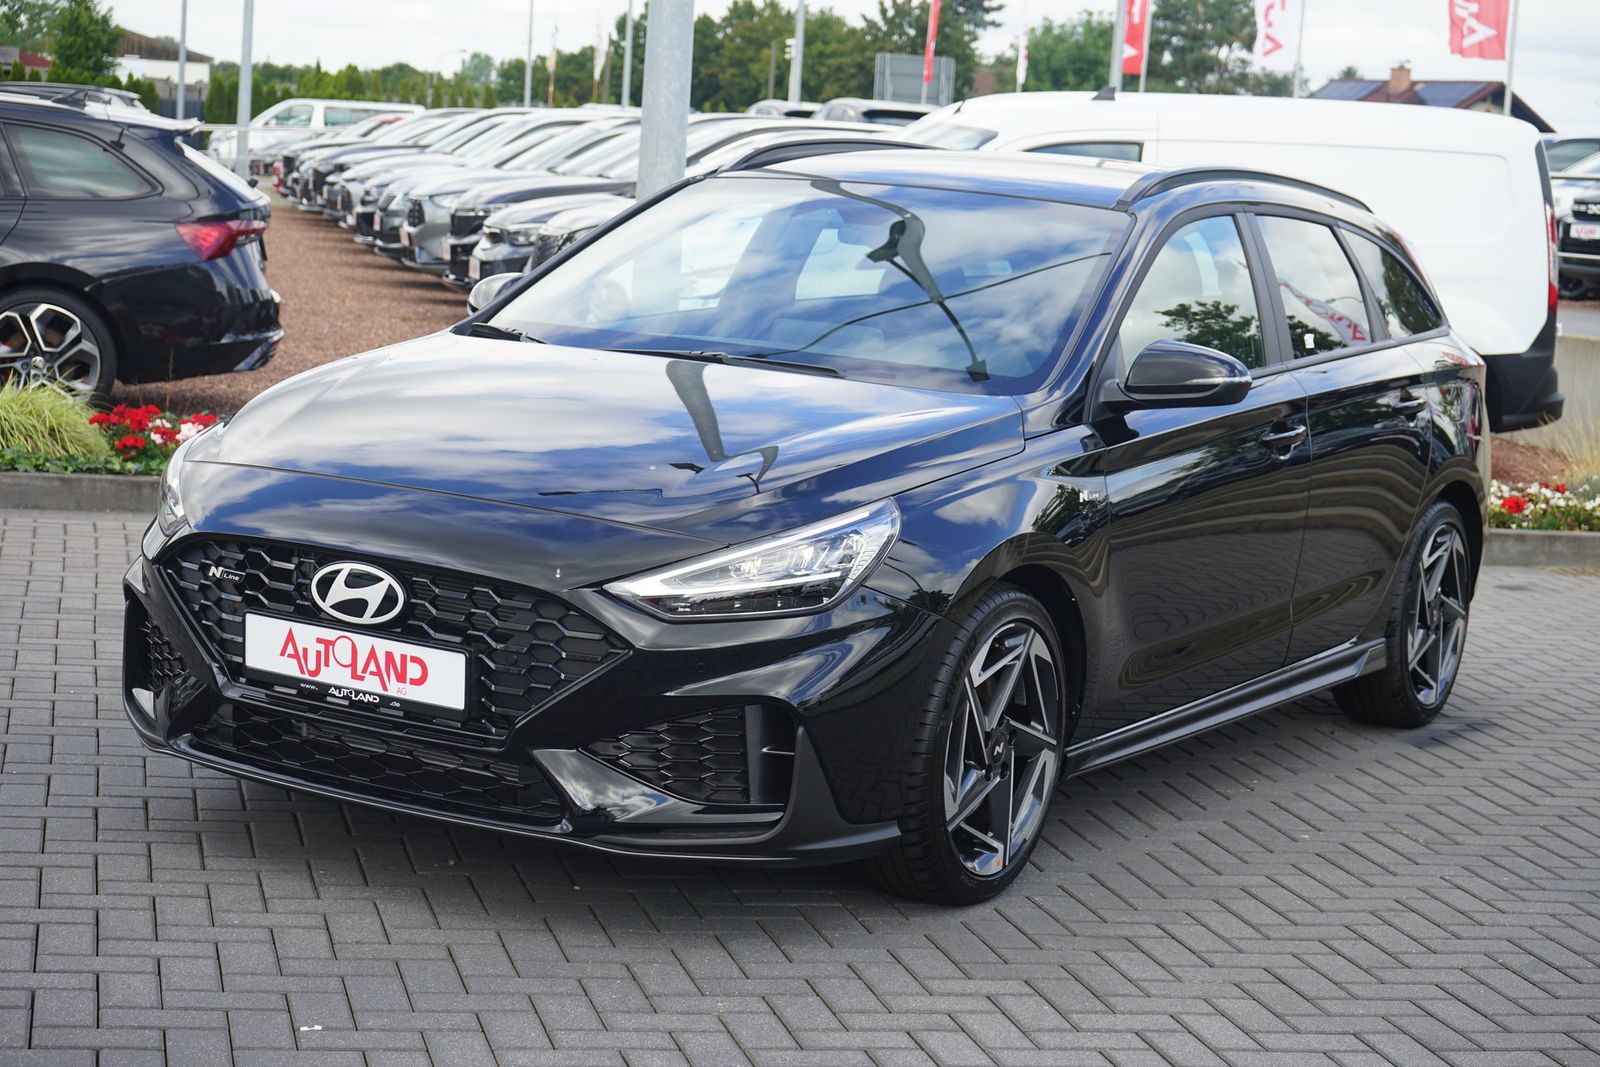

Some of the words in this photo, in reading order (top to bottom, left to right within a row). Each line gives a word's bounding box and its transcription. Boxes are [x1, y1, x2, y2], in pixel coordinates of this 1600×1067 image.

[208, 565, 224, 578] N
[223, 572, 240, 581] Line
[279, 626, 429, 692] AUTOLAND
[300, 683, 319, 691] www.
[328, 686, 380, 703] AUTOLAND
[396, 686, 407, 696] AG
